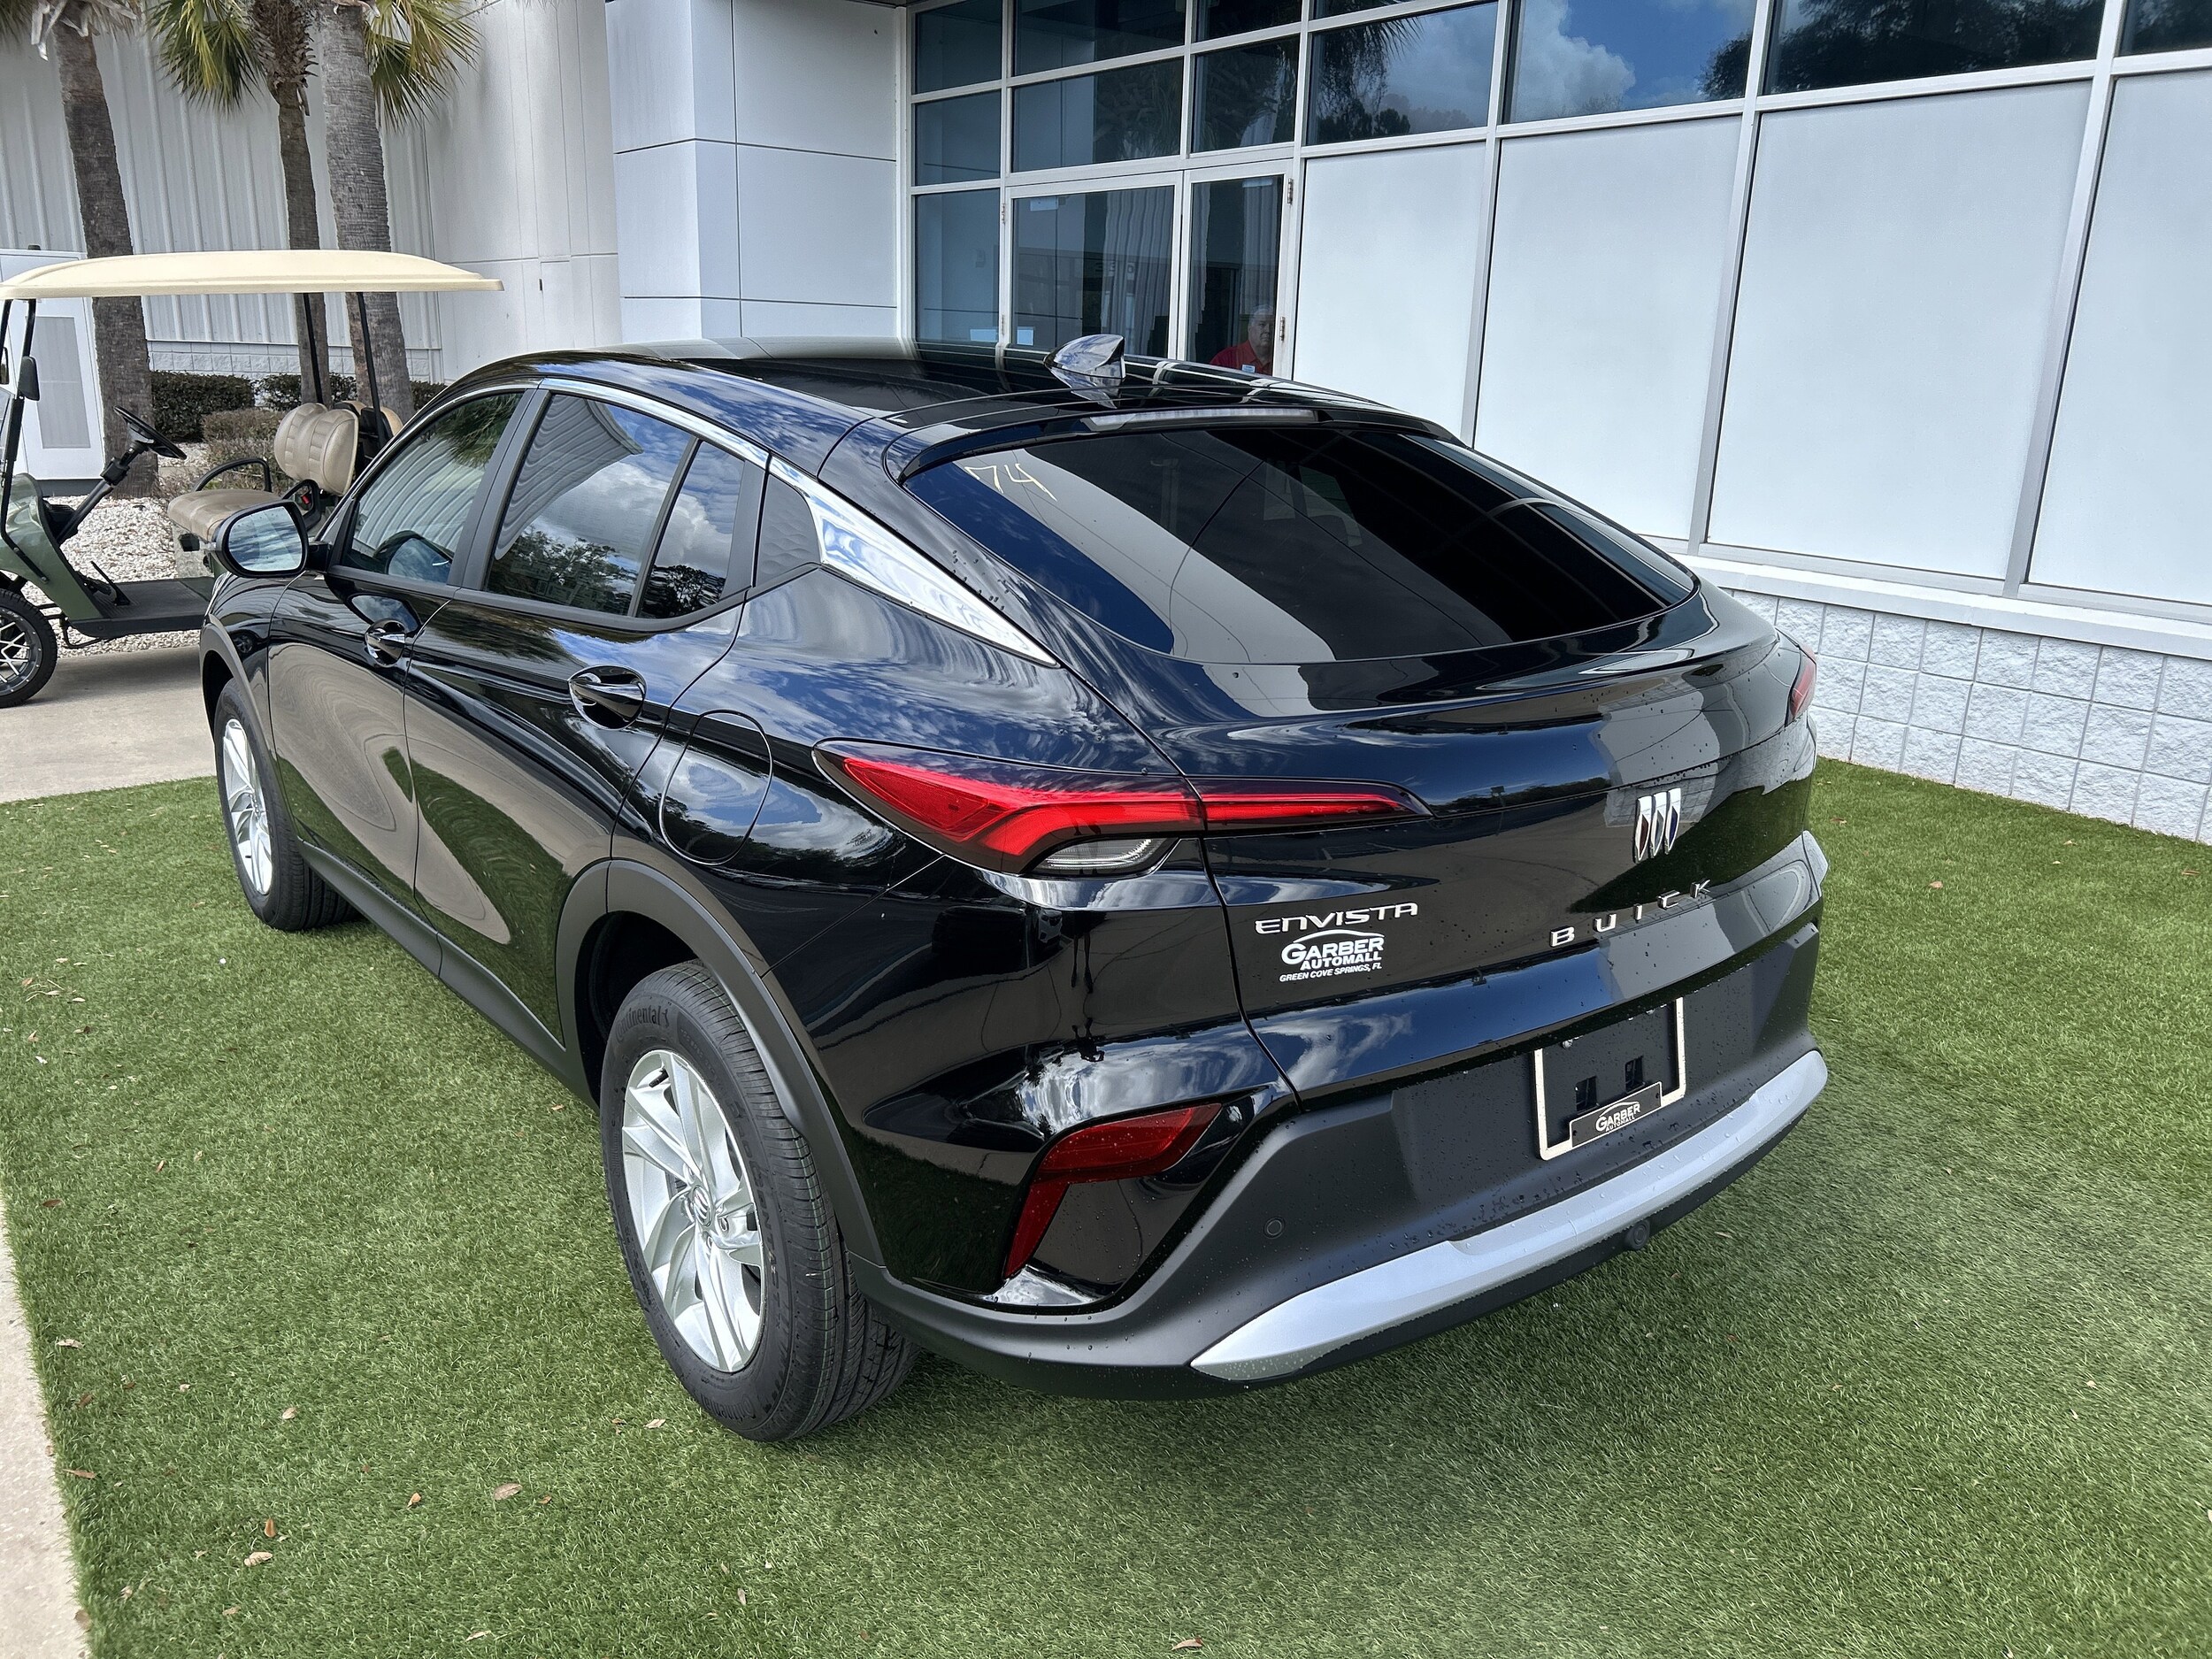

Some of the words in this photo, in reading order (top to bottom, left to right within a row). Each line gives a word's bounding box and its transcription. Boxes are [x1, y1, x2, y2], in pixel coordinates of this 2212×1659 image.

[964, 463, 1057, 502] 74
[1255, 902, 1418, 934] ENVISTA
[1550, 879, 1711, 948] BUICK
[1281, 938, 1385, 964] GARBER
[1300, 951, 1382, 971] AUTOMALL
[1279, 972, 1309, 982] GREEN
[1310, 968, 1333, 979] COVE
[1333, 964, 1371, 975] SPRINGS,
[1595, 1103, 1640, 1132] GARBER
